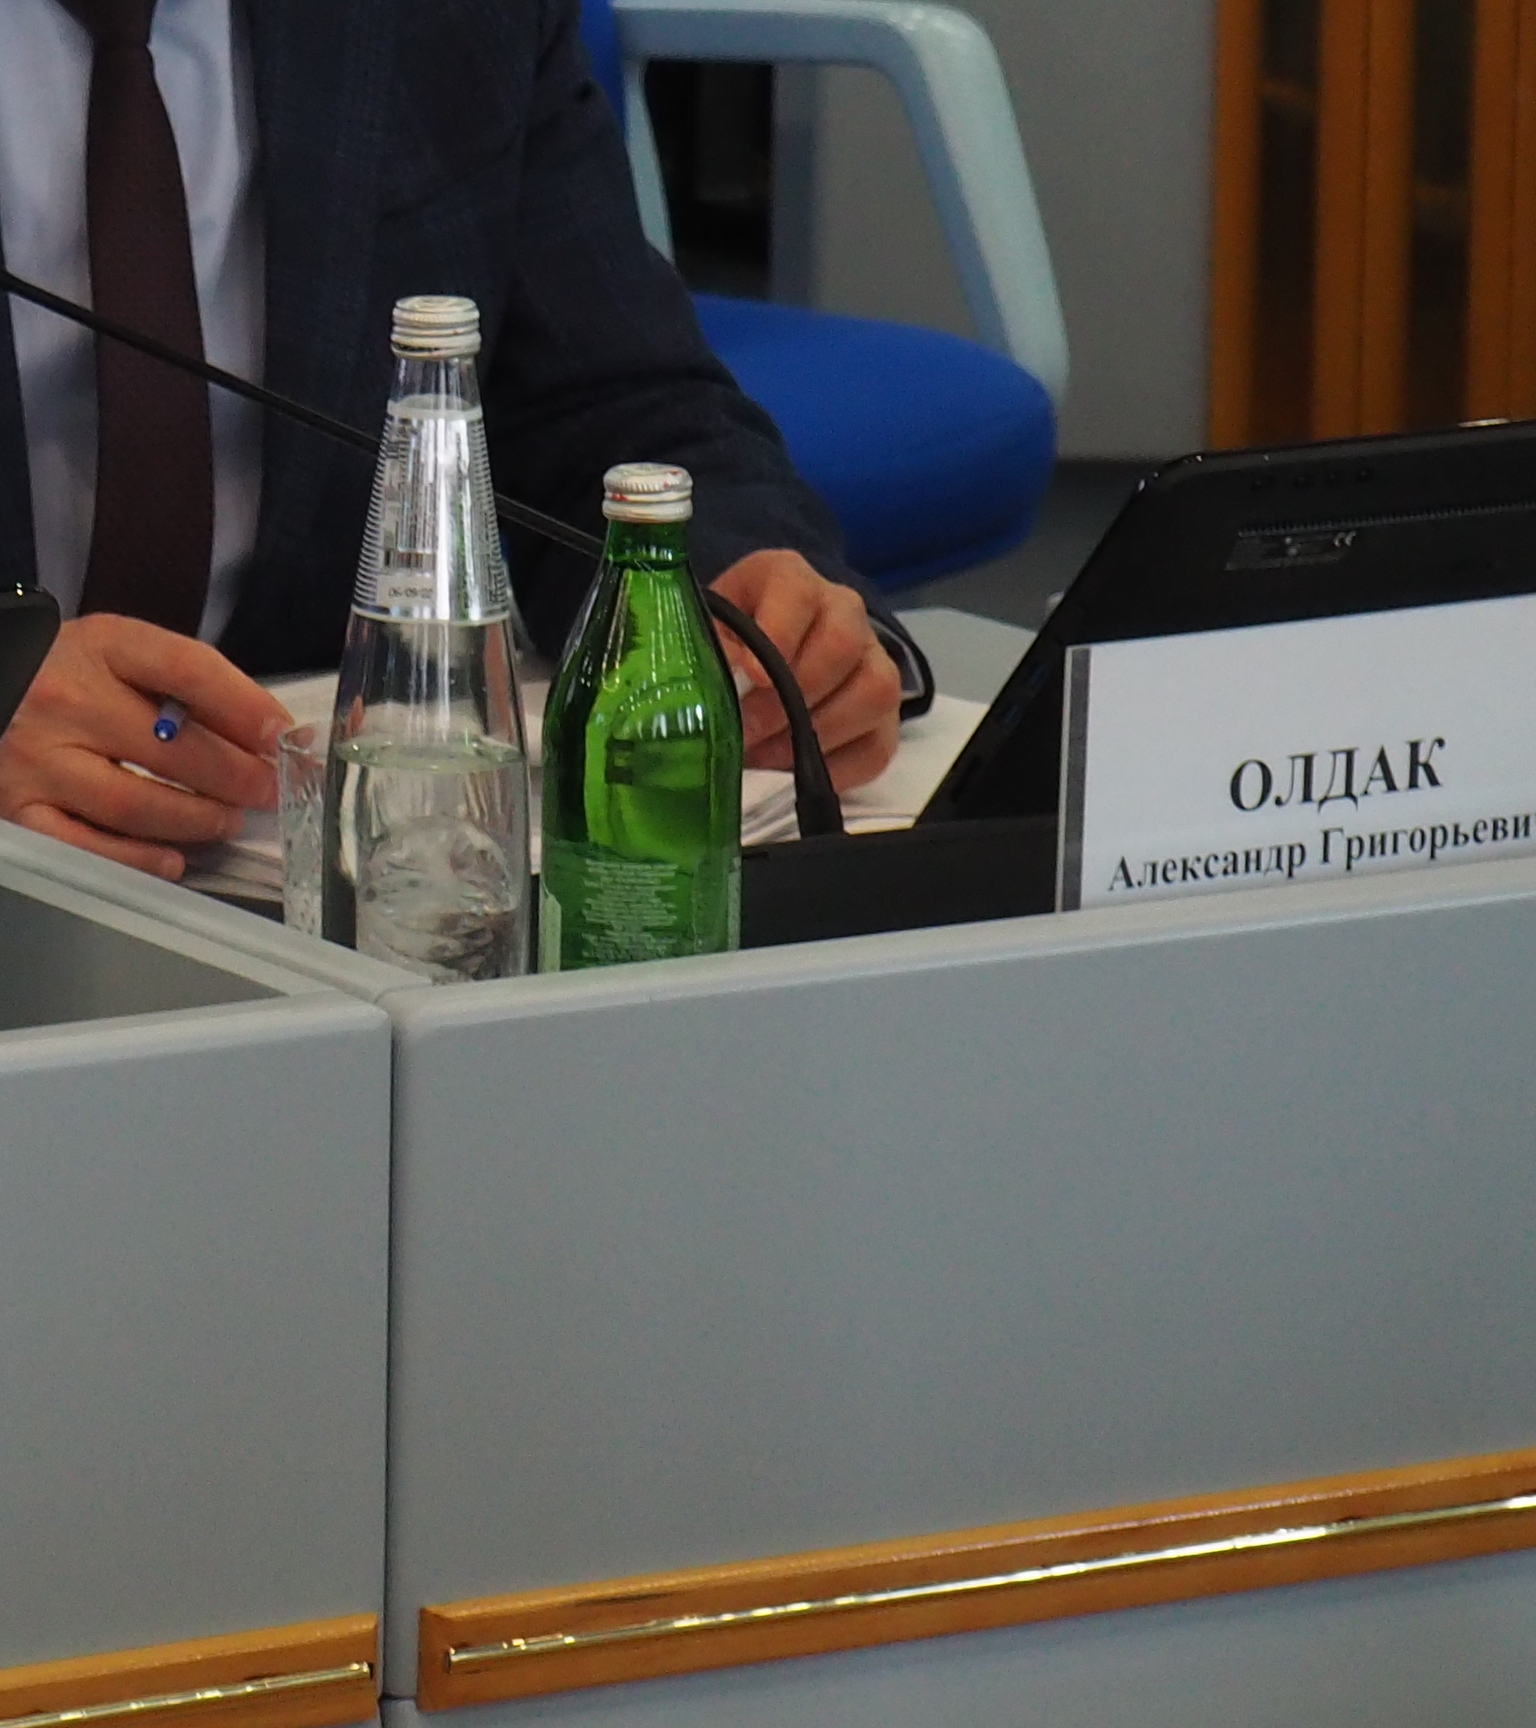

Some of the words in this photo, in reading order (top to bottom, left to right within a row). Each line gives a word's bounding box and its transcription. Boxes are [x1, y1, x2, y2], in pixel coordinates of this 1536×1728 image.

[1229, 736, 1447, 813] ОЛДАК
[1108, 840, 1307, 892] Александр
[1319, 812, 1536, 871] Григорьеви
